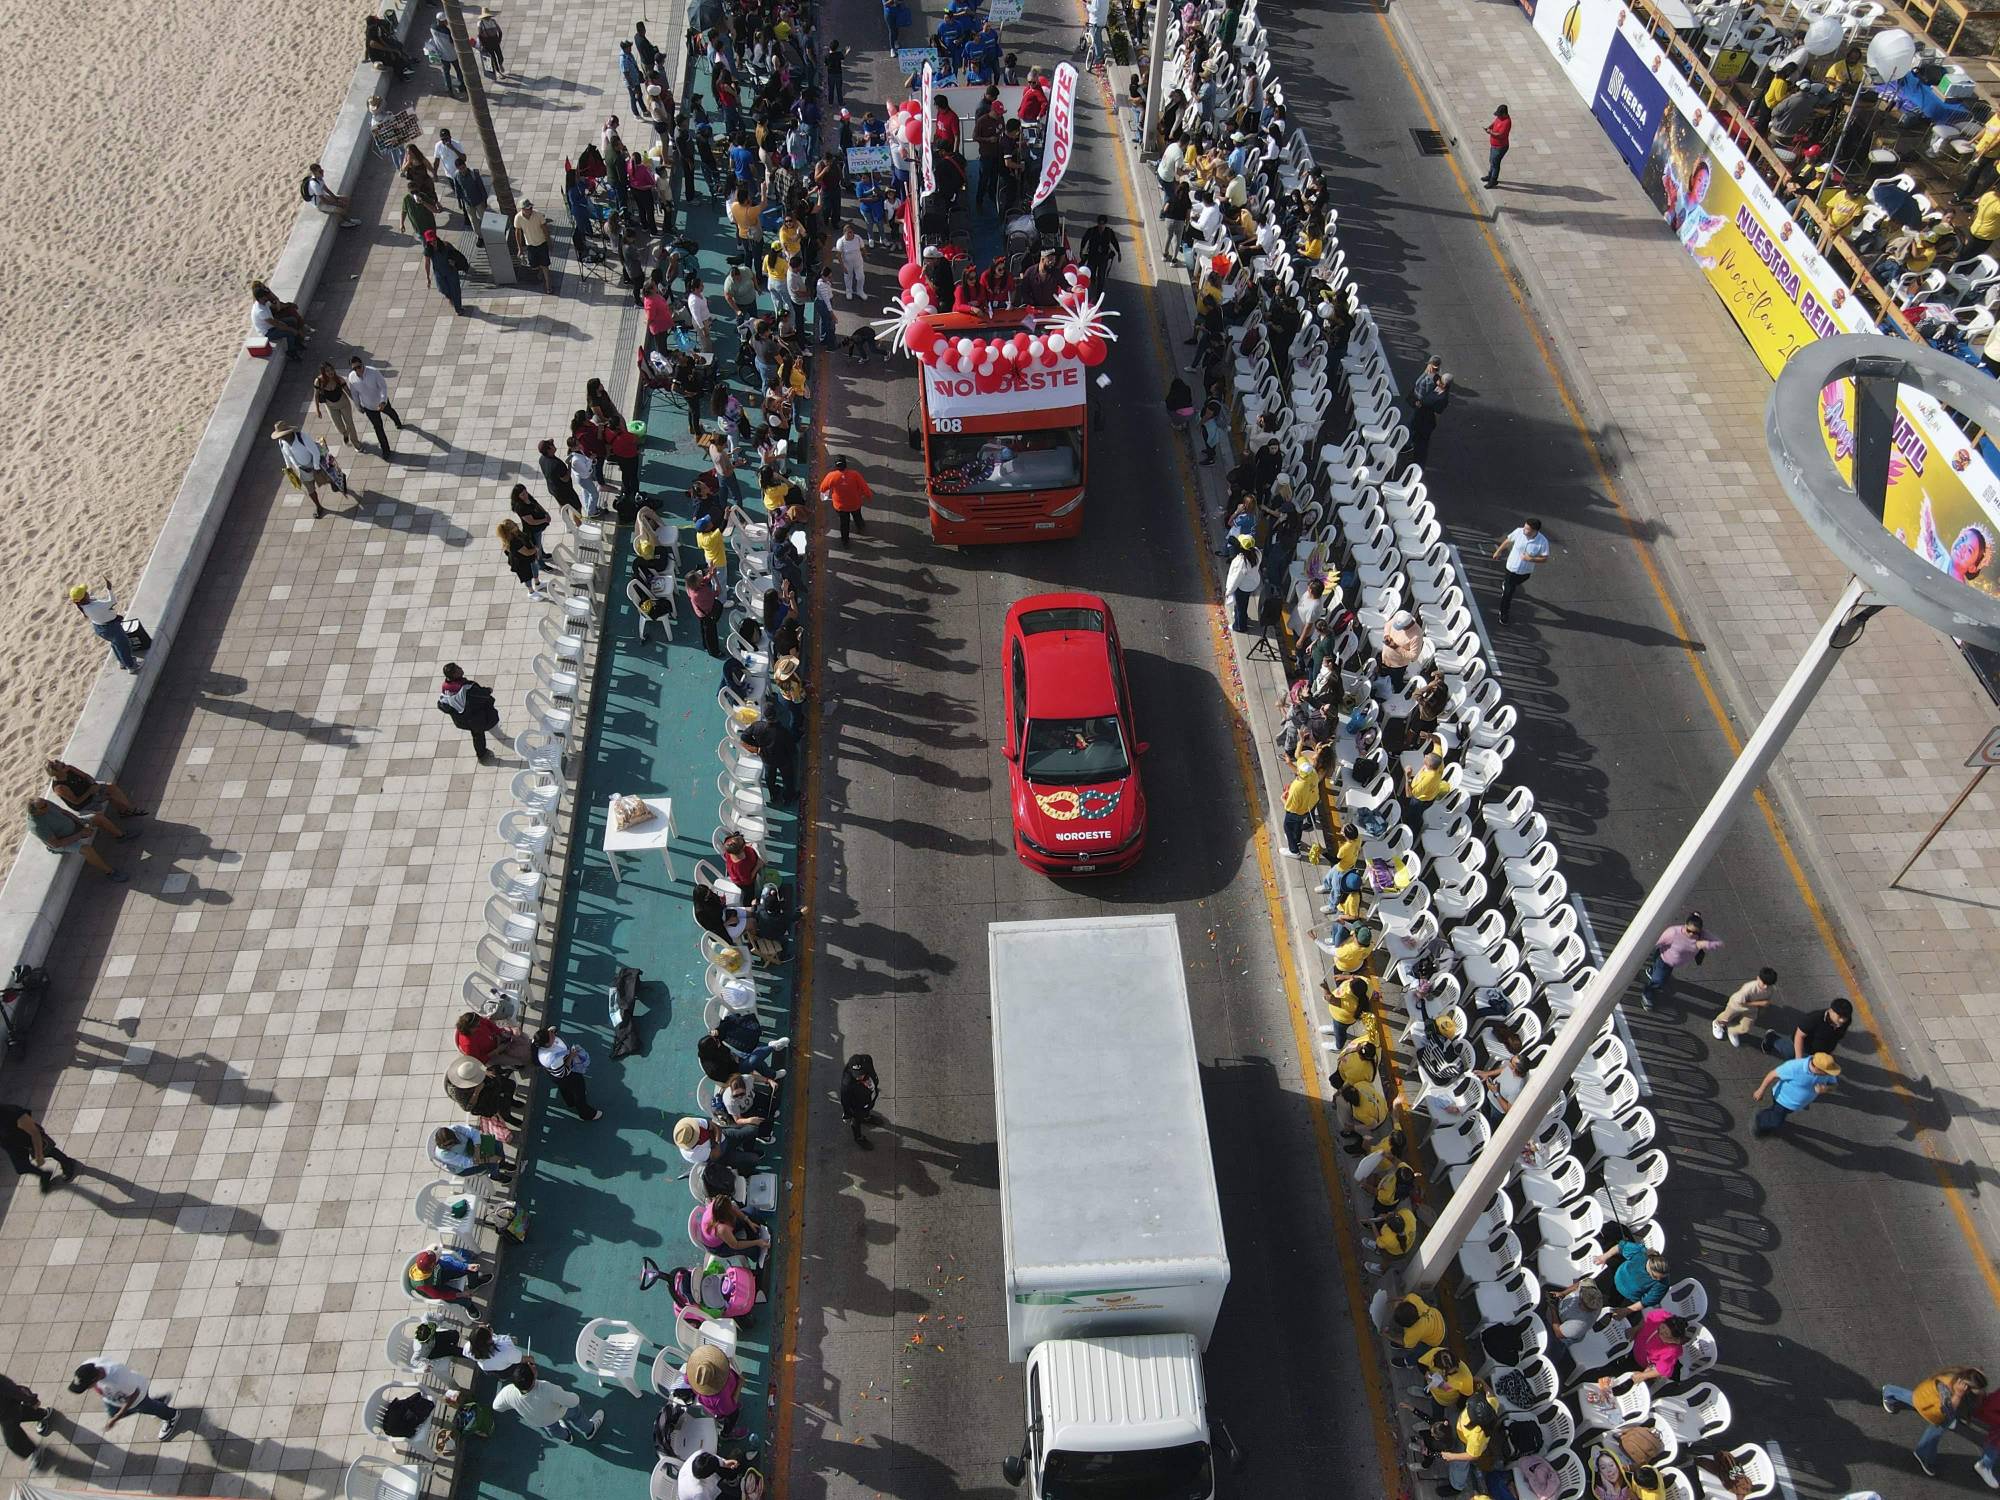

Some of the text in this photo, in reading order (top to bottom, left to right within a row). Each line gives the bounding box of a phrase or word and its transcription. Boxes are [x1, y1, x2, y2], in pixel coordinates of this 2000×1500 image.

[1621, 83, 1647, 126] HERSA
[1735, 203, 1801, 304] NUESTRA
[931, 417, 963, 433] 108
[1055, 830, 1112, 842] NOROESTE
